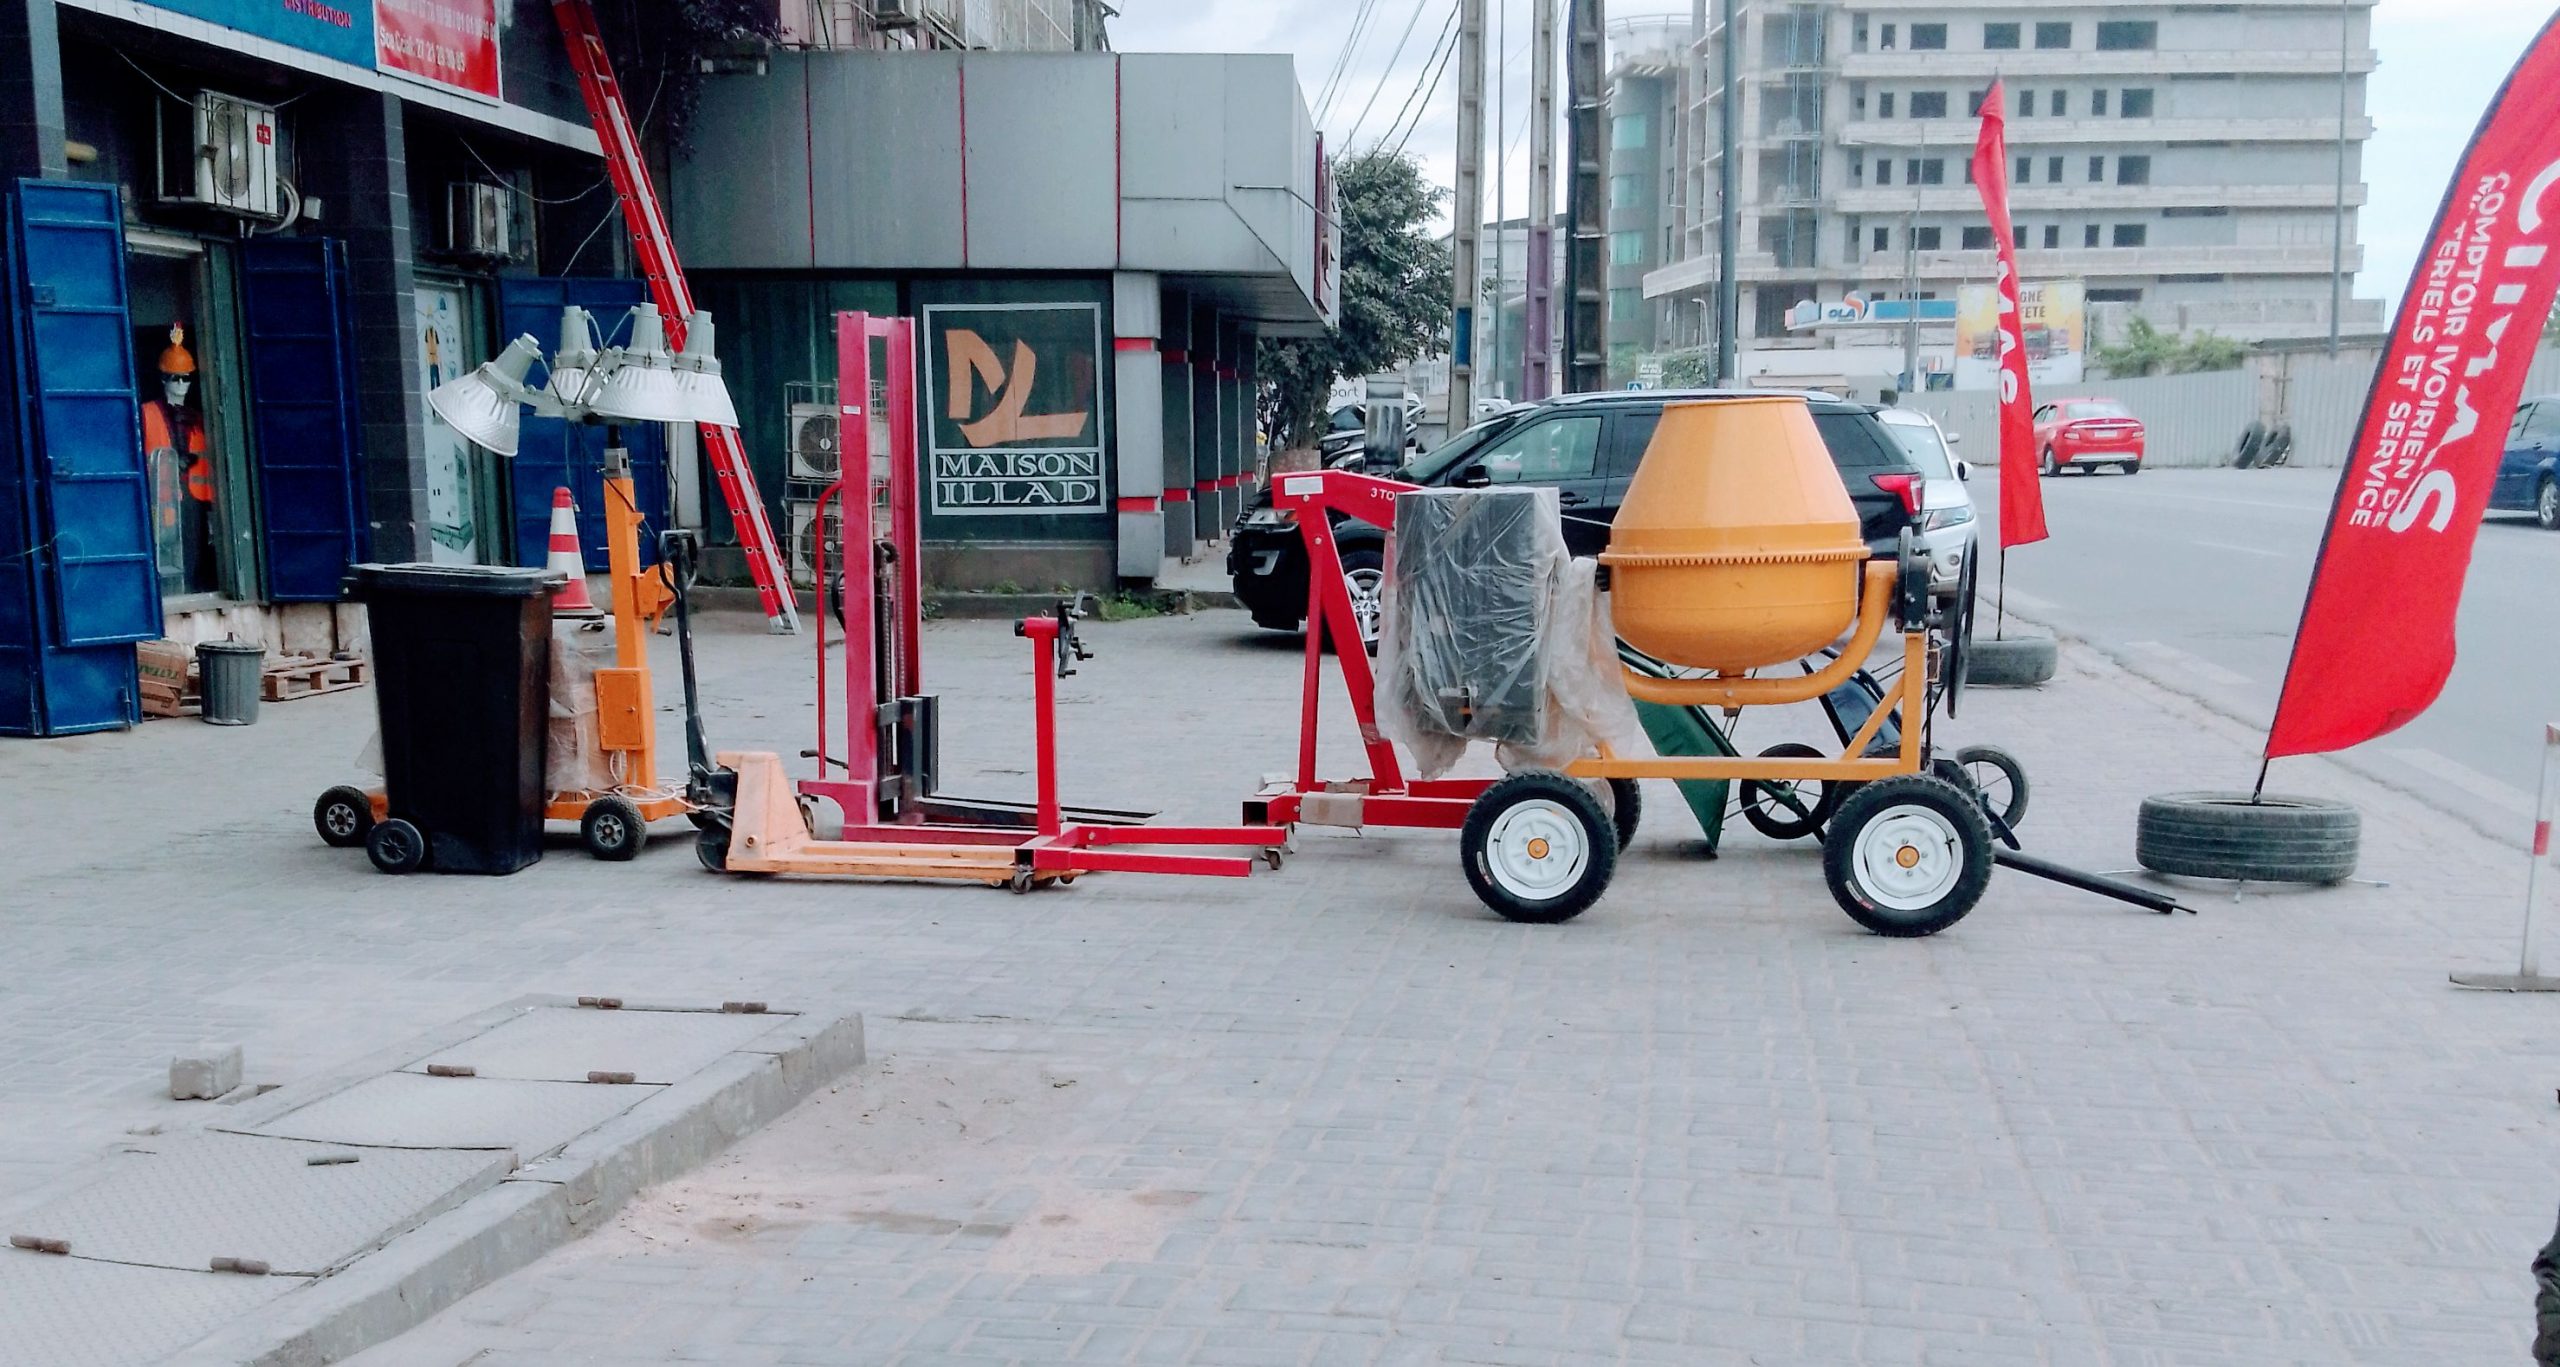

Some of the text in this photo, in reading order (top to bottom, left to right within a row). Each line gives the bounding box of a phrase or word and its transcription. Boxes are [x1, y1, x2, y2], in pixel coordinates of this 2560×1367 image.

[2443, 171, 2510, 337] COMPTOIR
[2020, 290, 2043, 303] GNE
[1829, 308, 1855, 318] OLA
[2020, 305, 2046, 318] ETE
[2349, 175, 2496, 527] MTERIELS ET SERVICE
[2393, 345, 2460, 480] IVOIRIEN
[940, 453, 1096, 477] MAISON
[941, 481, 1096, 504] ILLAD
[1371, 487, 1396, 501] 3 TO
